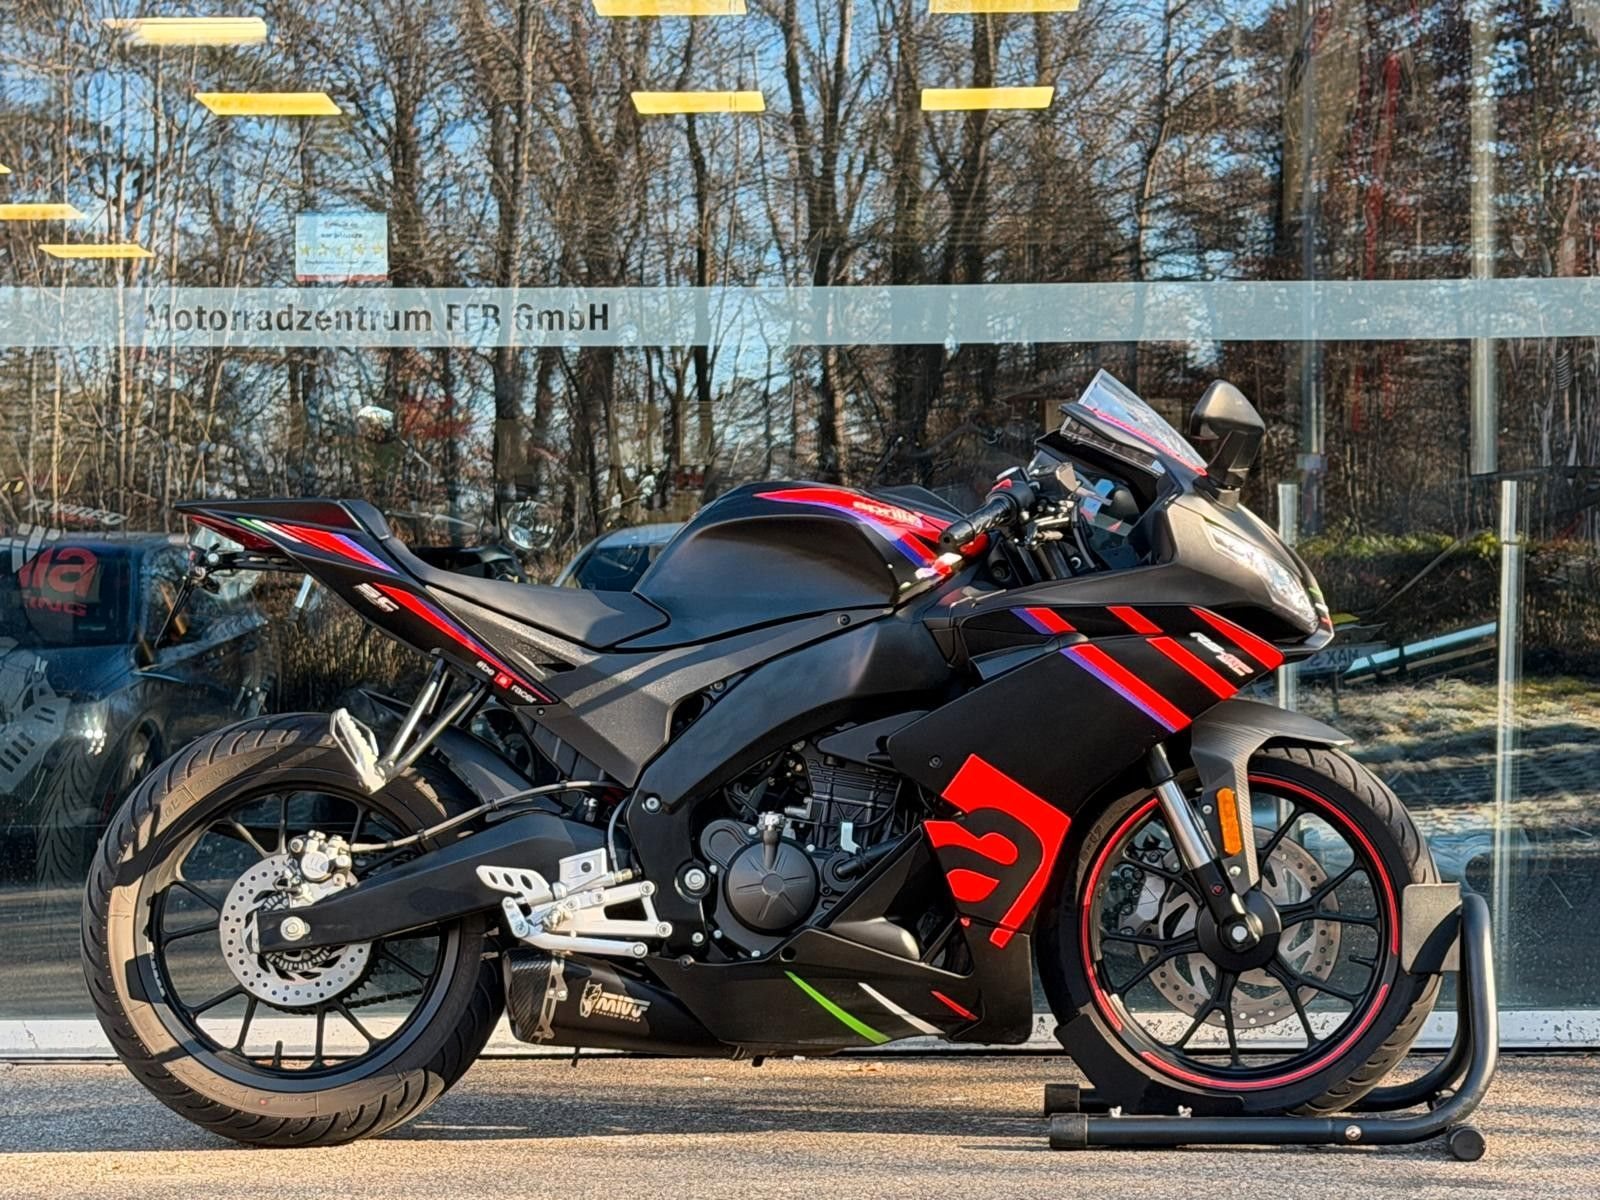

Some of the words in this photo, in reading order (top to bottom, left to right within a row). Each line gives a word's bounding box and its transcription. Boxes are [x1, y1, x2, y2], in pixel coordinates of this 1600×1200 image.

[145, 302, 432, 332] Motorradzentrum
[514, 303, 609, 332] GmbH
[511, 684, 537, 703] racer
